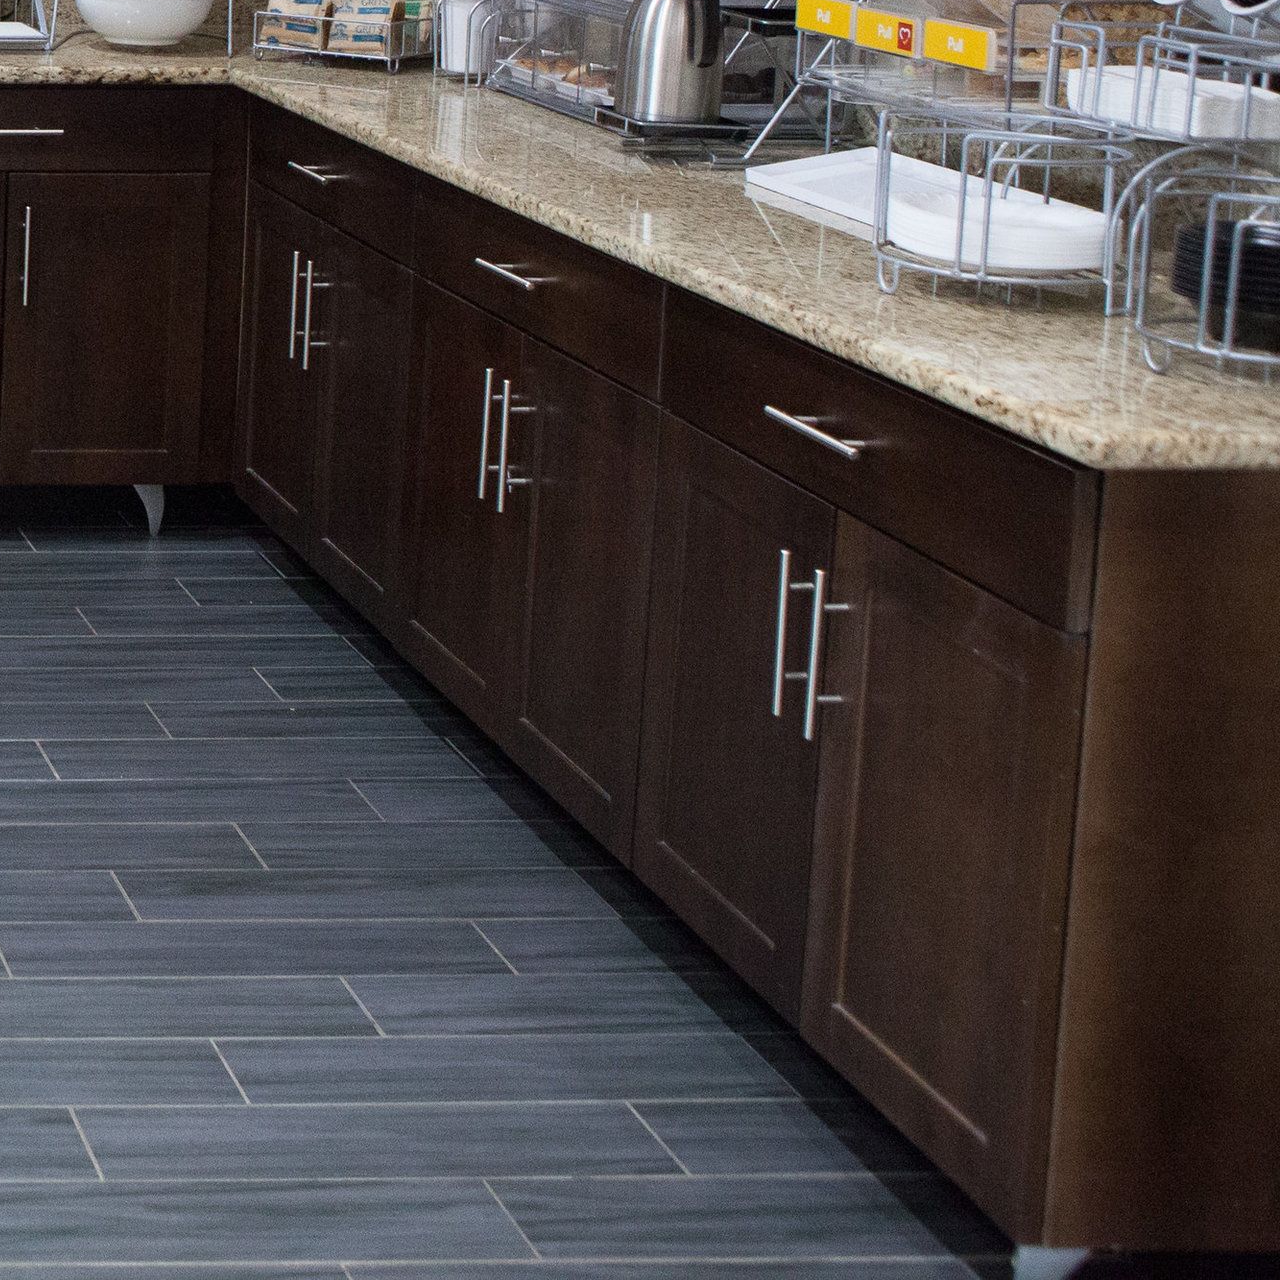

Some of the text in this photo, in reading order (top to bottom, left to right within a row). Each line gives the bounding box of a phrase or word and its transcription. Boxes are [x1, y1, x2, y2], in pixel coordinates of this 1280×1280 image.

[816, 9, 831, 24] Pull
[877, 24, 893, 40] Pull
[947, 36, 965, 53] Pull
